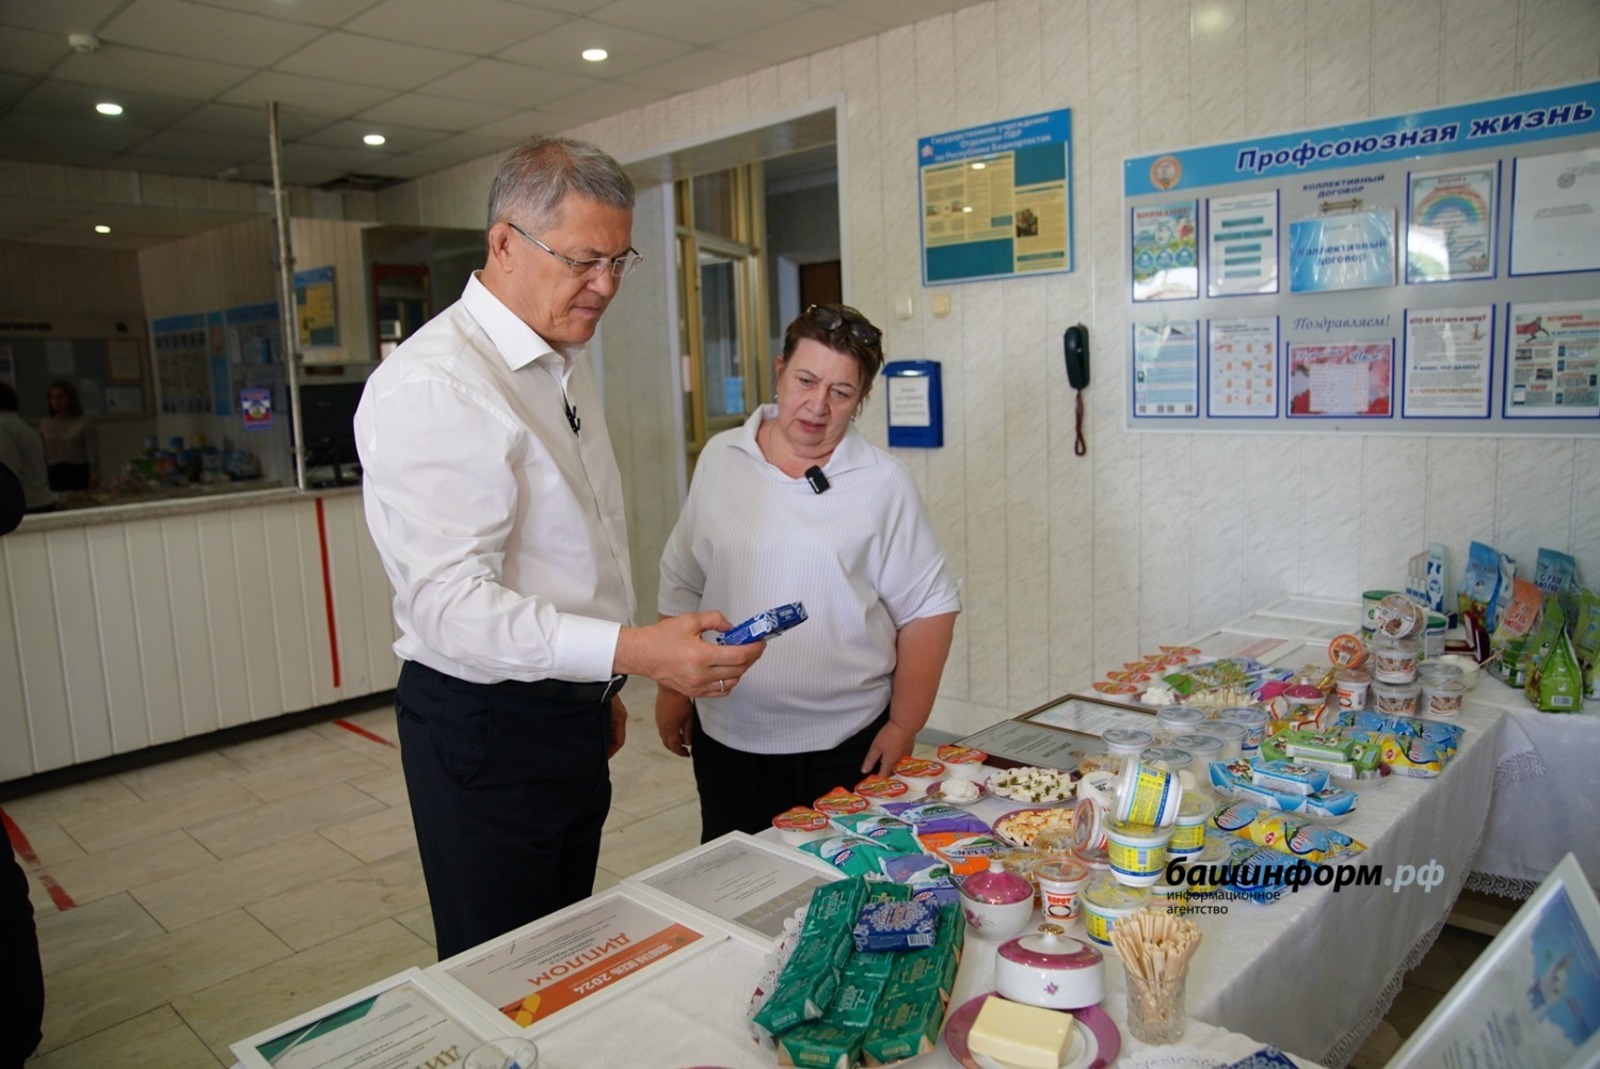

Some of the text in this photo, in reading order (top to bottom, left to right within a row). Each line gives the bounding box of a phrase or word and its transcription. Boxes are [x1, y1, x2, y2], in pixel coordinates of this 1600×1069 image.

[1236, 101, 1595, 175] Профсоюзная жизнь
[1293, 314, 1391, 332] Поздравляем!
[527, 932, 631, 987] ДИПЛОМ
[572, 972, 612, 995] 2024
